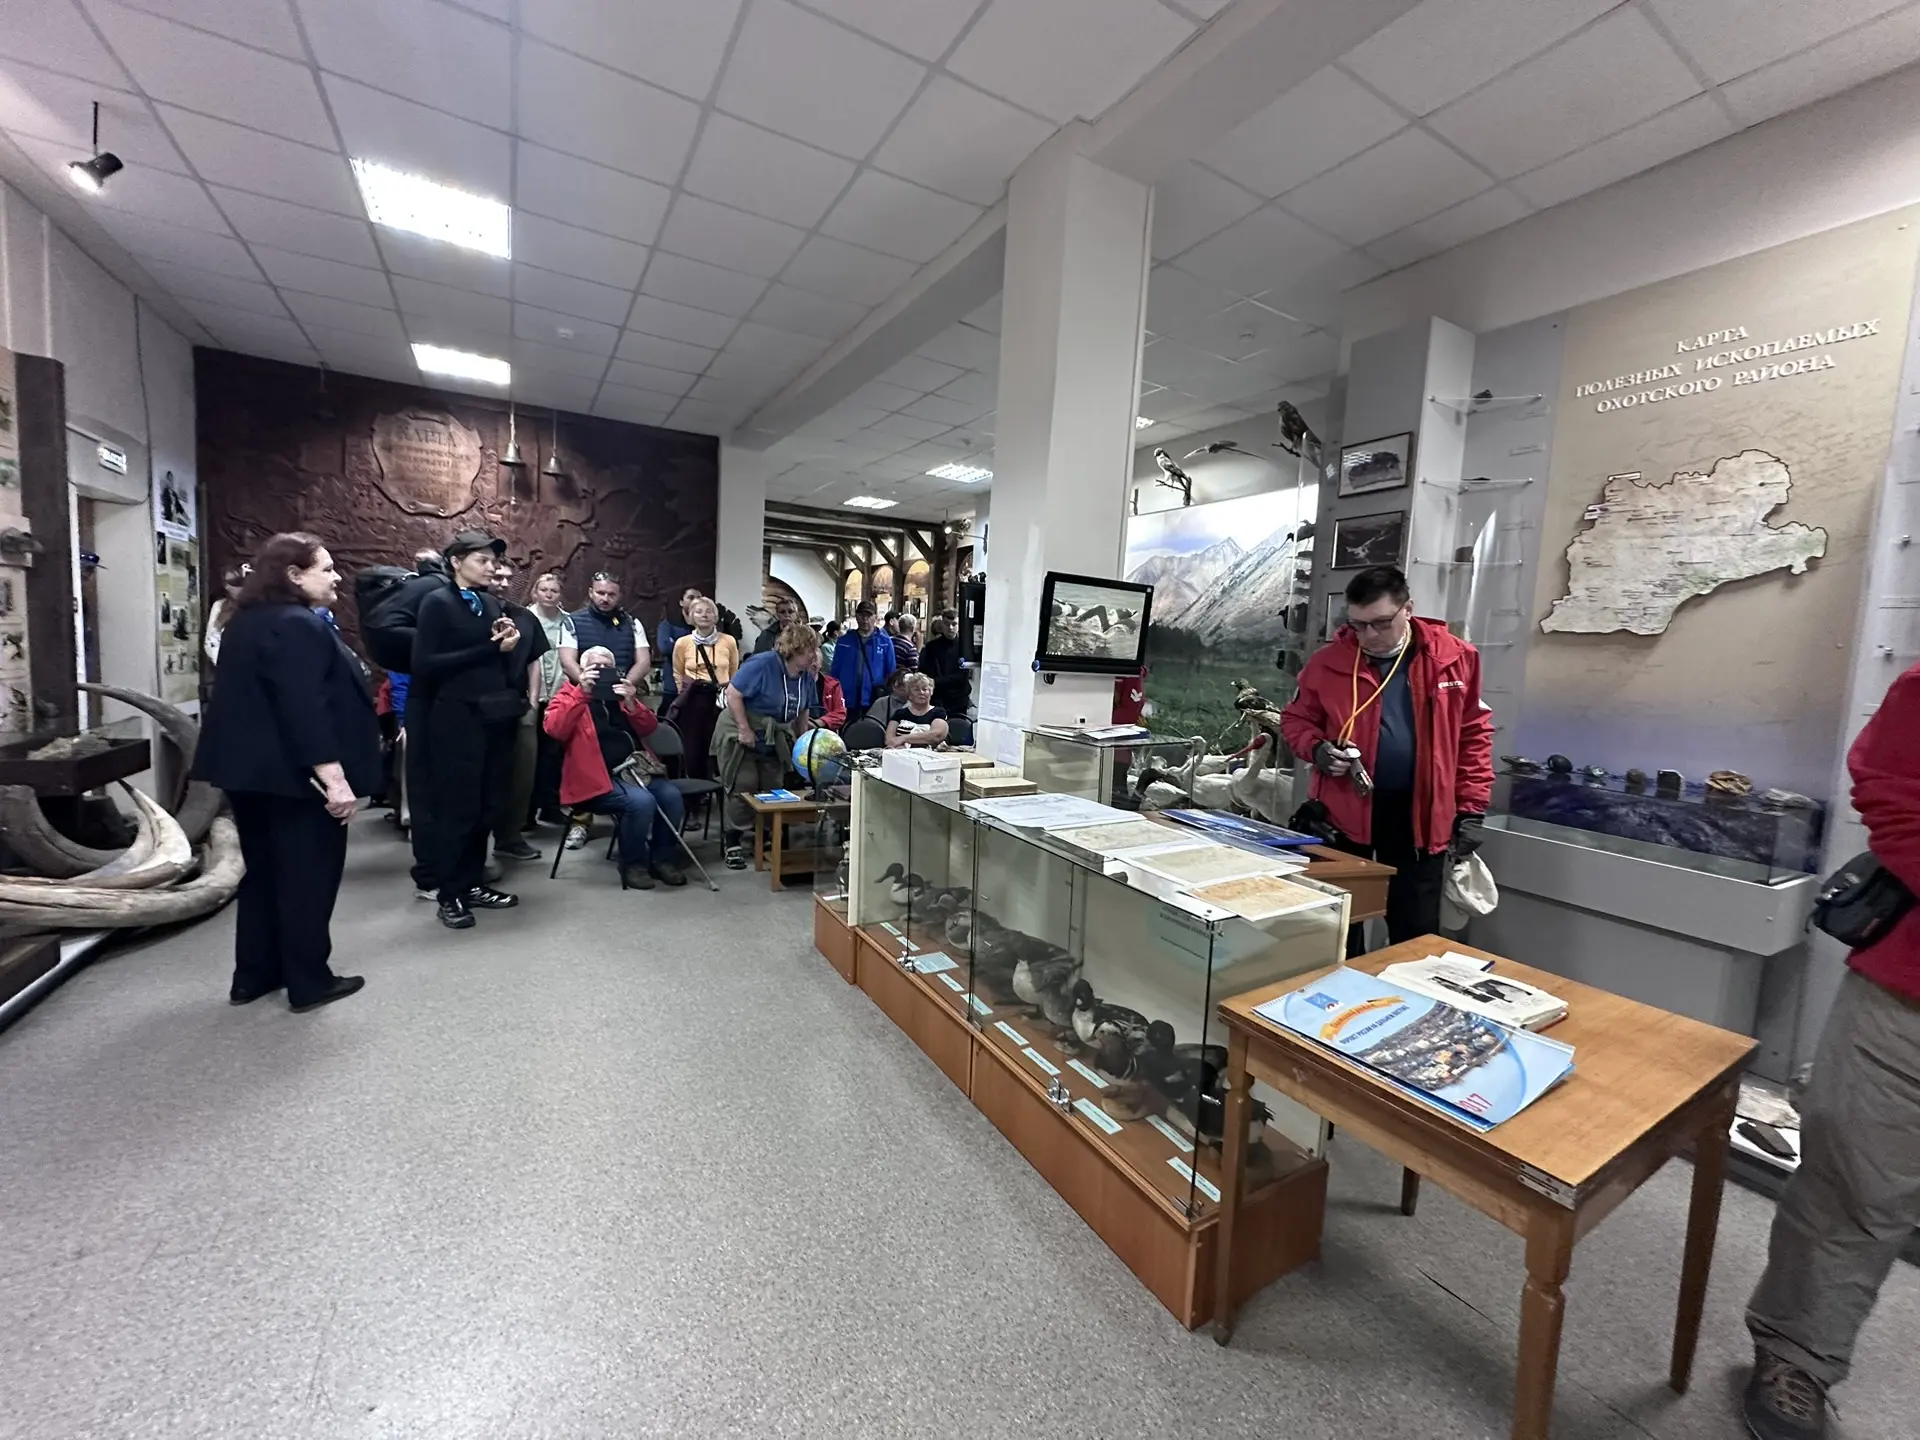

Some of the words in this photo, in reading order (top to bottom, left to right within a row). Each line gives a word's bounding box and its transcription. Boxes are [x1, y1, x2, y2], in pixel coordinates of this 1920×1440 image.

[1575, 363, 1683, 398] ПОЛЕЗНЫХ
[1694, 319, 1880, 372] ИСКОПАЕМЫХ
[1676, 326, 1749, 353] КАРТА
[1596, 377, 1723, 413] ОХОТСКОГО
[1732, 354, 1836, 387] РАЙОНА
